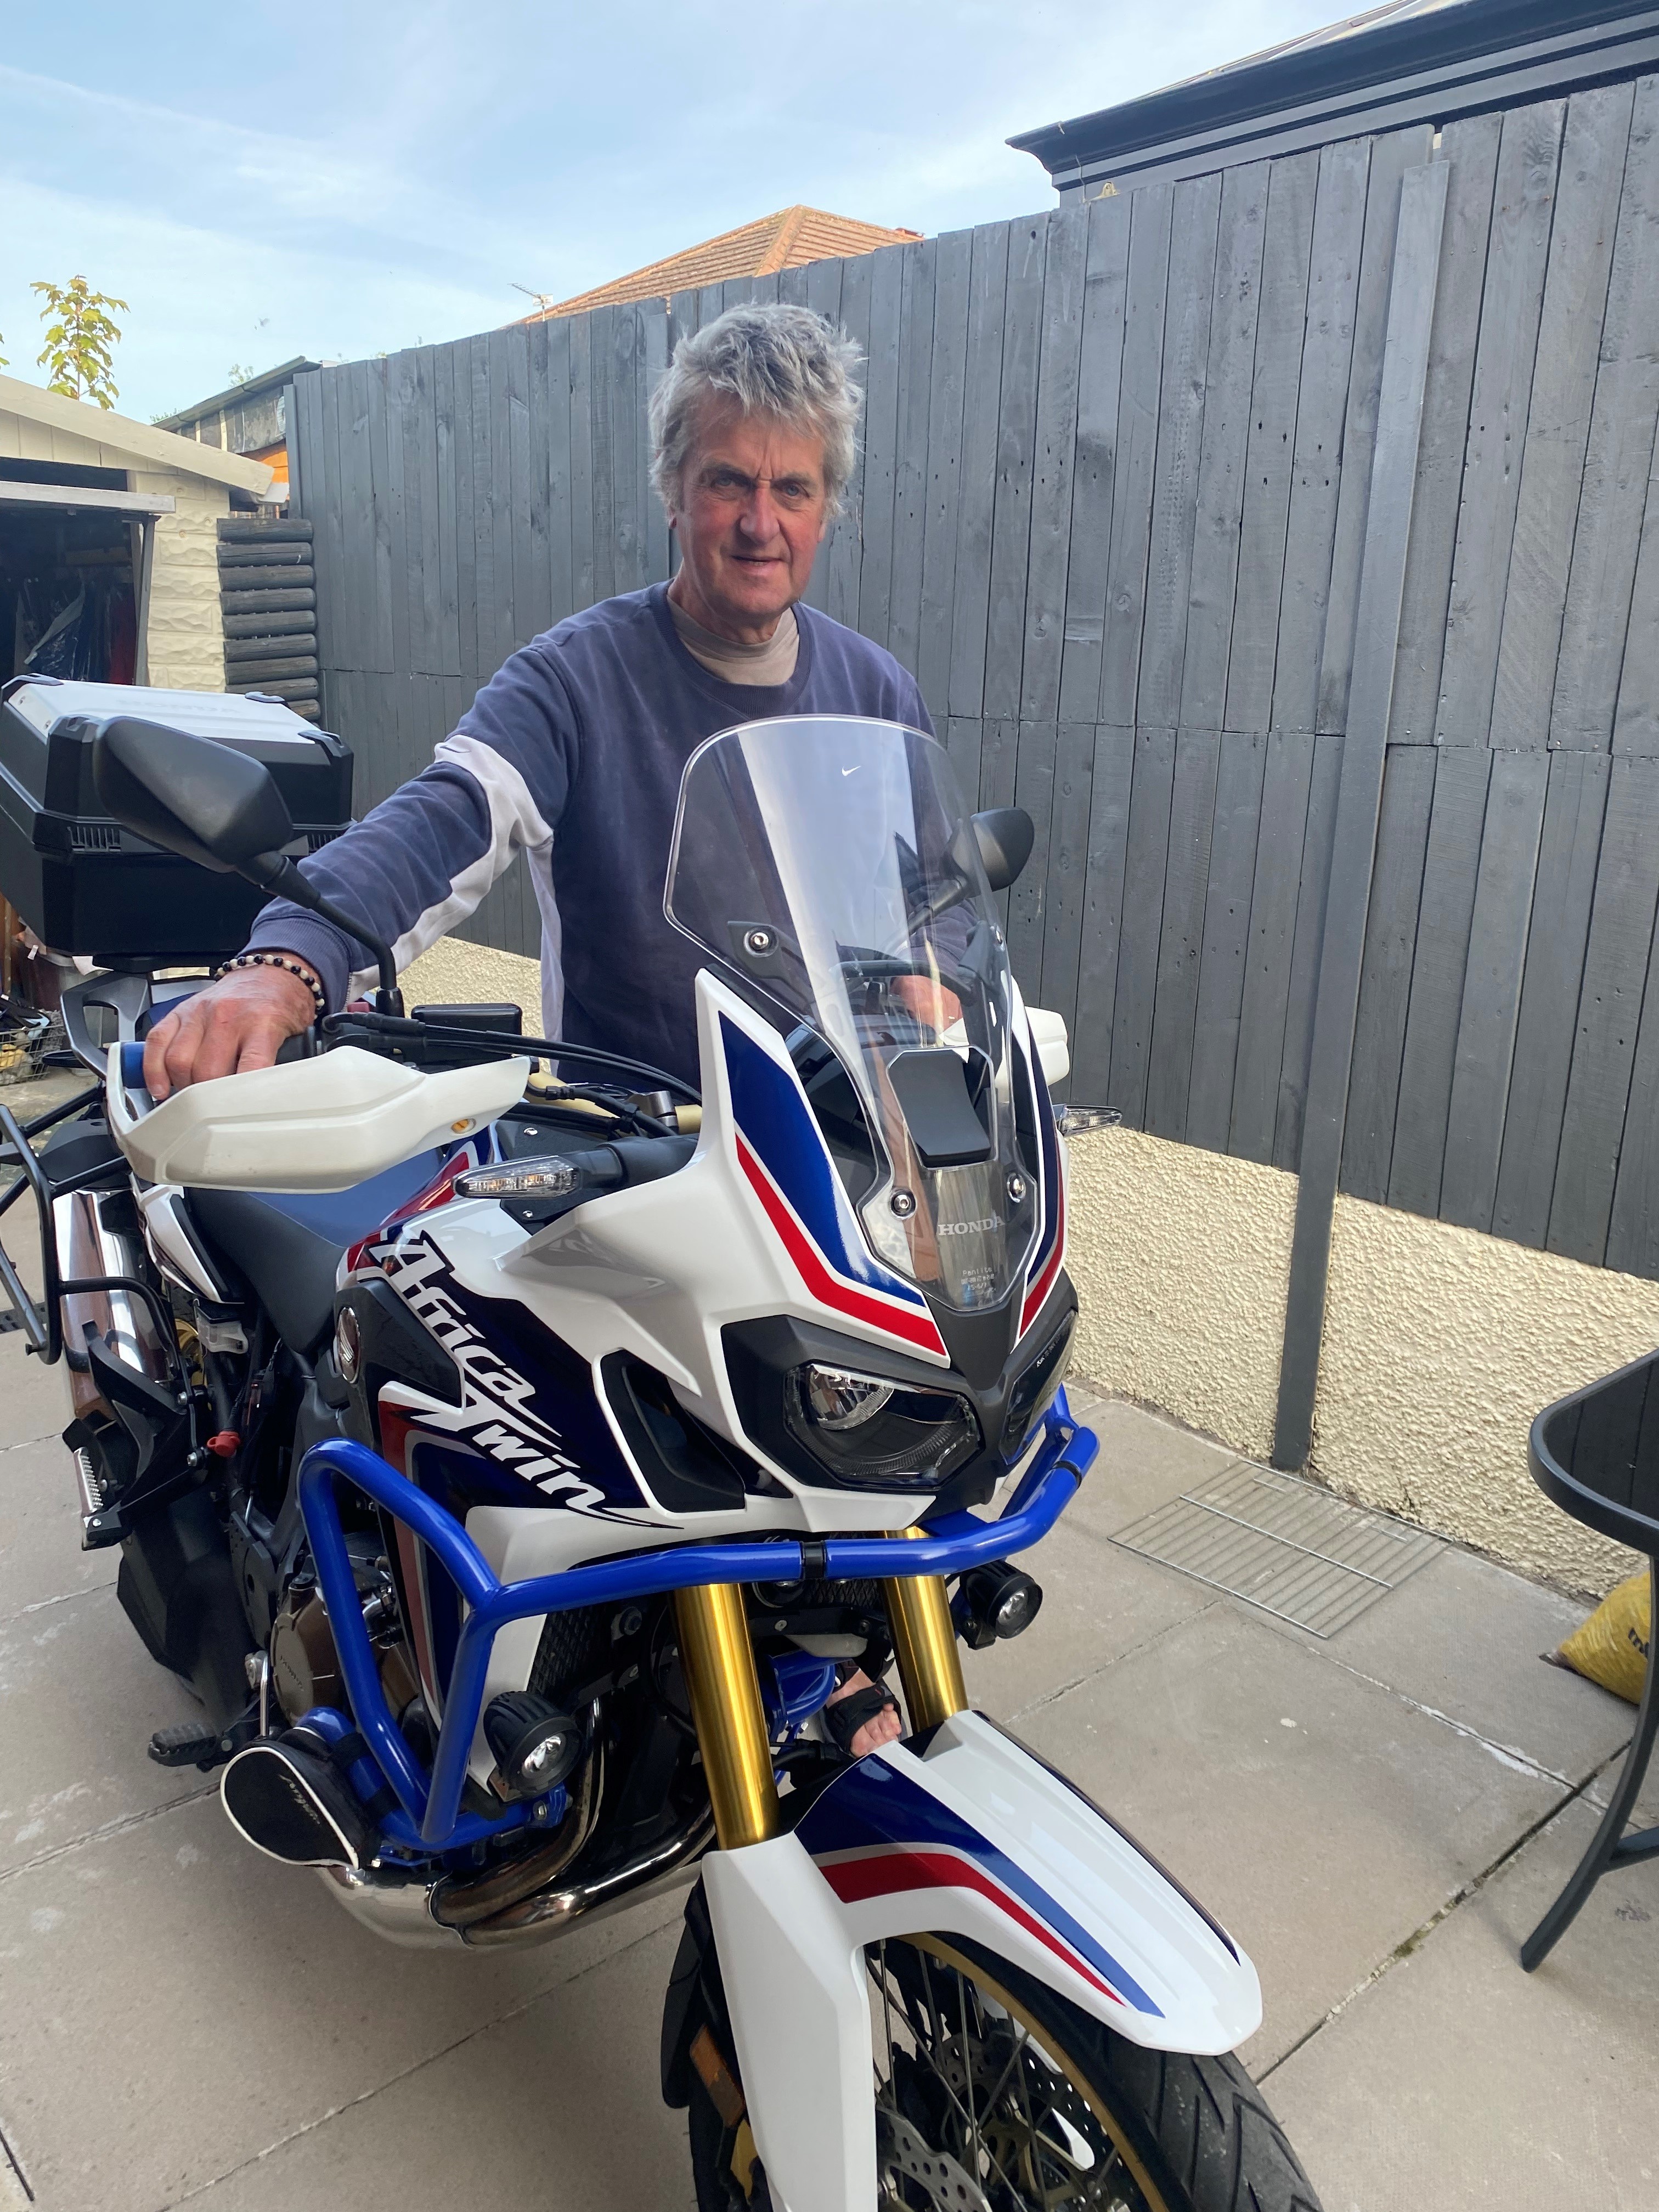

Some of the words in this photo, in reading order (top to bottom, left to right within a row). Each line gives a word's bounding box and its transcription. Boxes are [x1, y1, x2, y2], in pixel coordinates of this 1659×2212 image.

[938, 1216, 1005, 1235] HONDA
[369, 1232, 562, 1436] Africa
[410, 1381, 653, 1525] Twin
